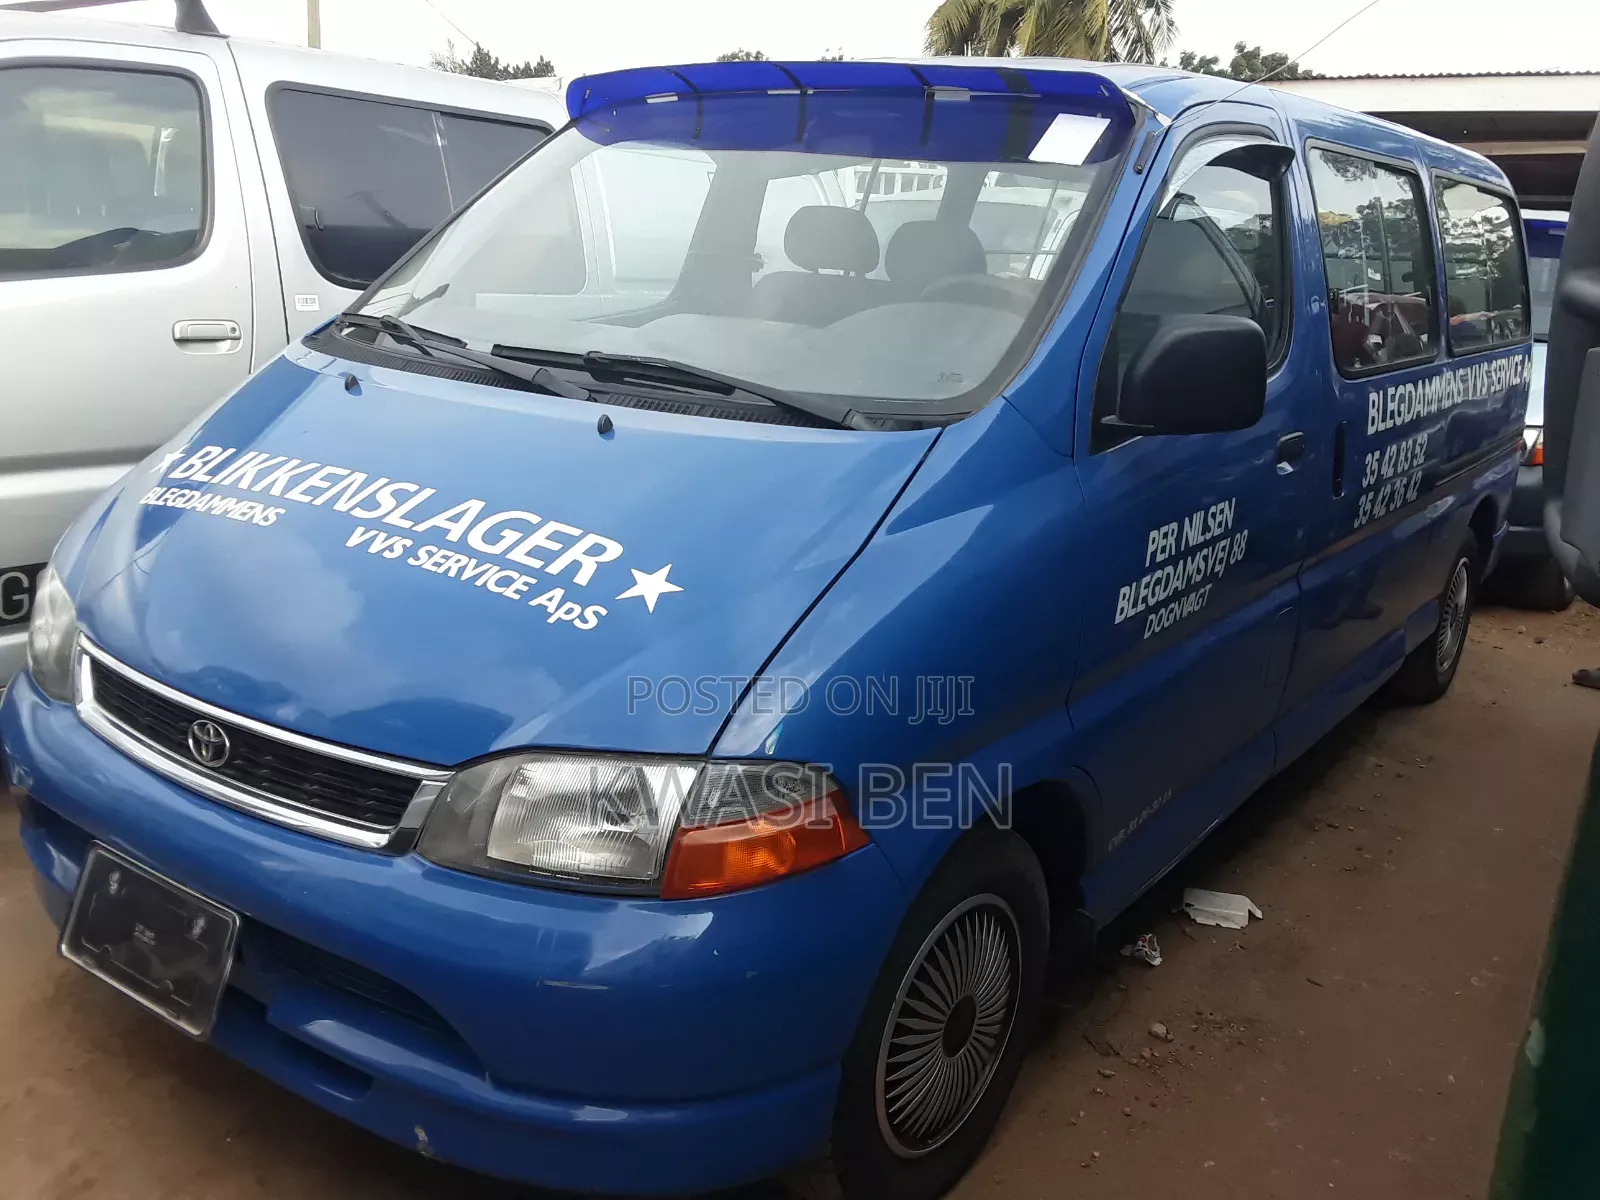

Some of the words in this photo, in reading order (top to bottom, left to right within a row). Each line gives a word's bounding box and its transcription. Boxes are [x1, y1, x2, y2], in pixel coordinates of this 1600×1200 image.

[1367, 368, 1464, 435] BLEGDAMMENS
[1468, 362, 1488, 399] VVS
[1490, 354, 1523, 393] SERVICE
[1353, 491, 1375, 529] 35
[1372, 483, 1392, 519] 42
[1389, 476, 1408, 512] 36
[1405, 470, 1423, 503] 42
[1362, 450, 1380, 488] 35
[1381, 444, 1397, 479] 42
[1413, 432, 1428, 467] 52
[168, 445, 624, 587] BLIKKENSLAGER
[1145, 521, 1179, 568] PER
[1180, 497, 1236, 551] NILSEN
[139, 486, 286, 526] BLEGDAMMENS
[345, 525, 414, 559] VVS
[407, 545, 538, 600] SERVICE
[528, 587, 608, 630] ApS
[1114, 537, 1231, 624] BLEGDAMSVEJ
[1230, 529, 1248, 565] 88
